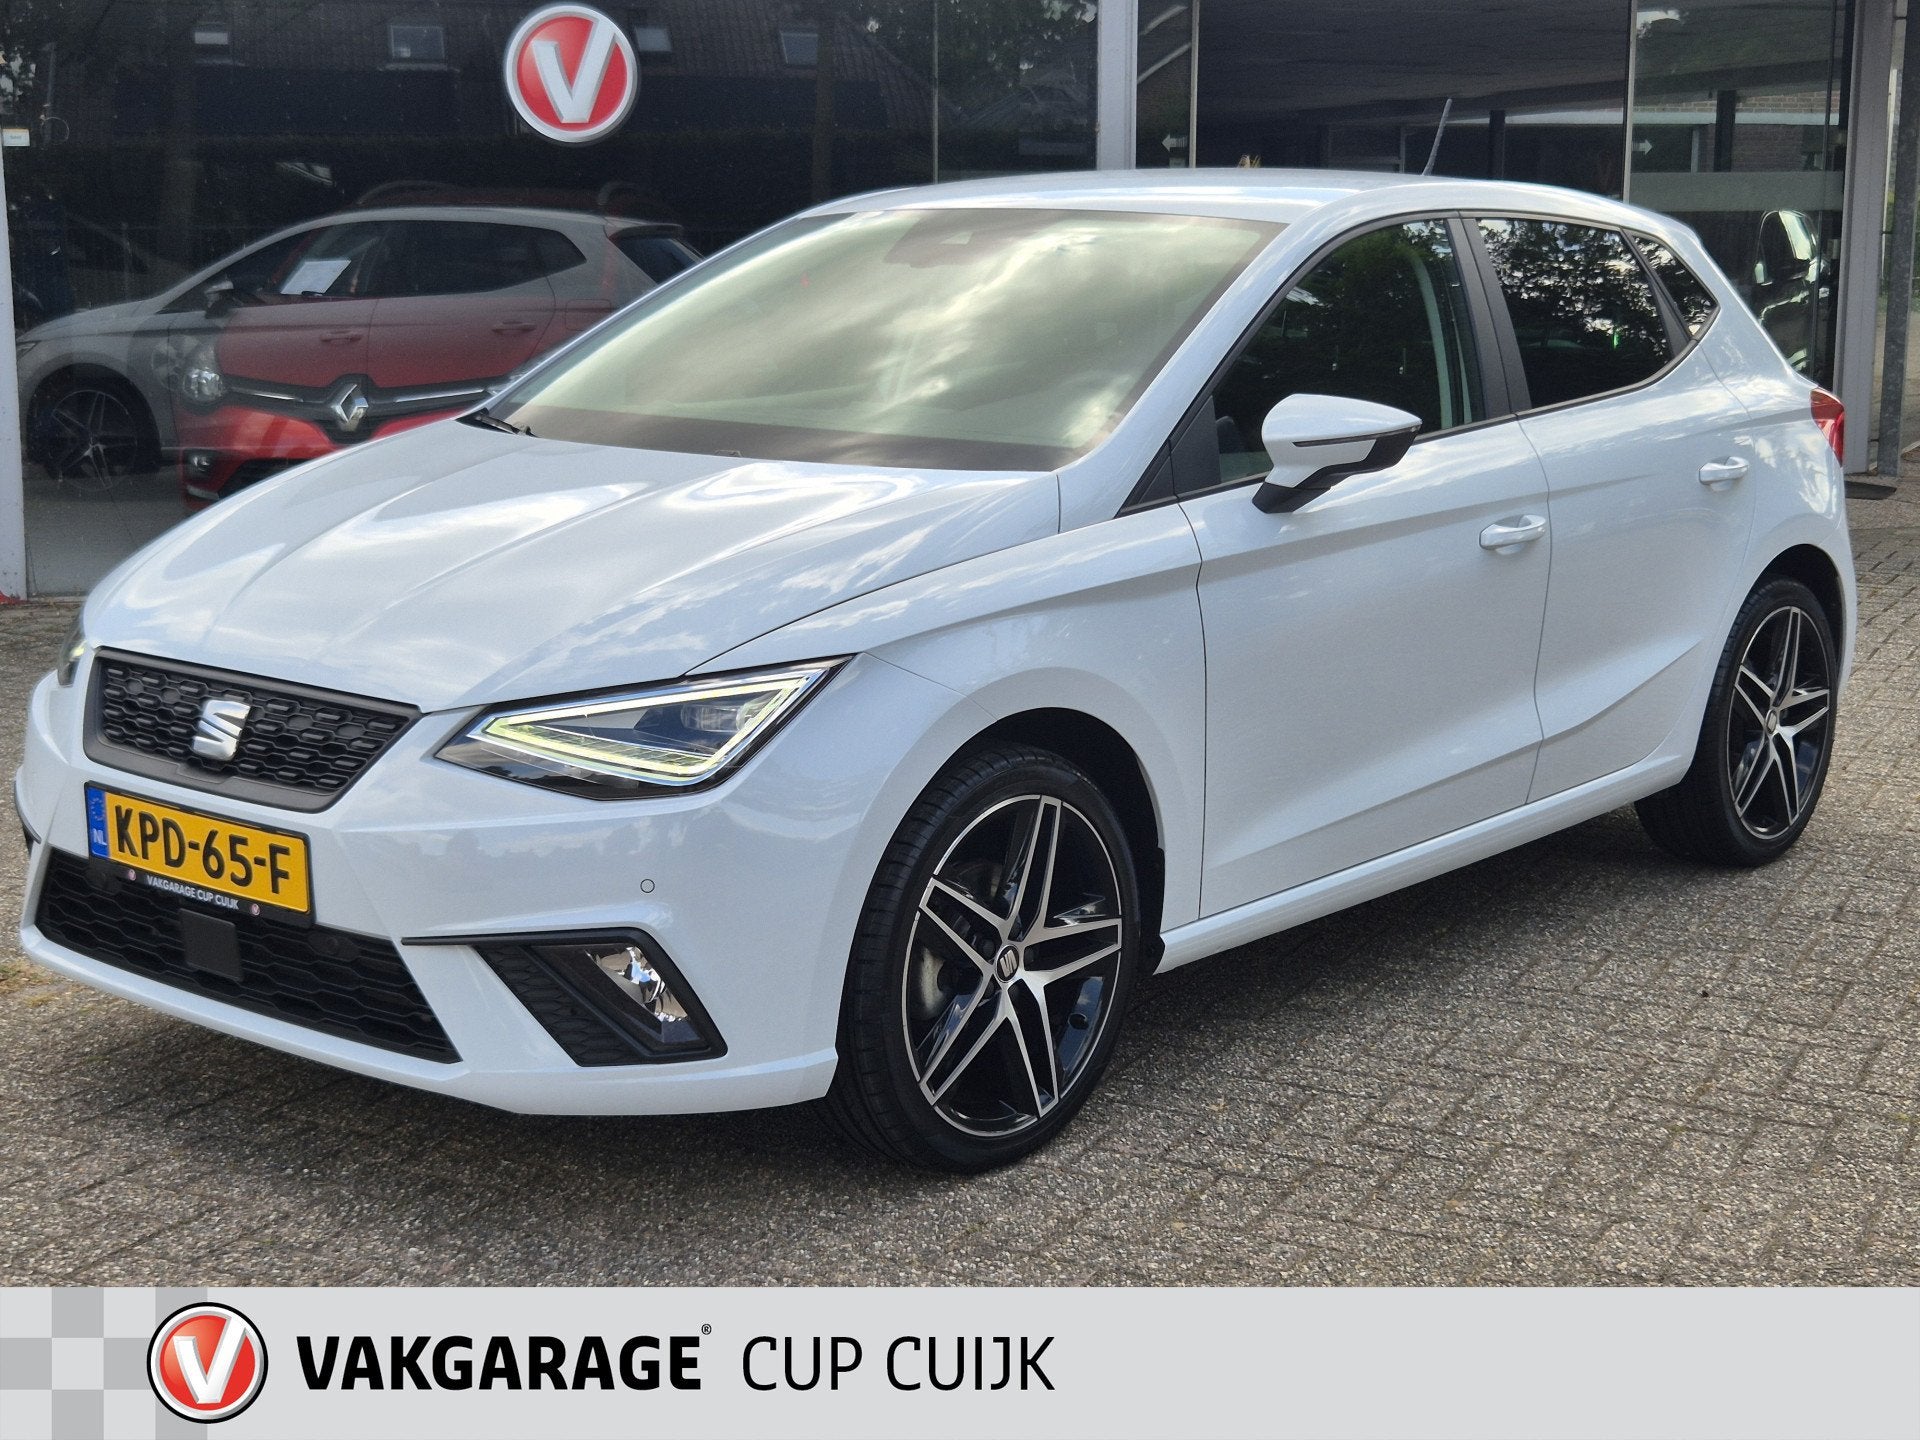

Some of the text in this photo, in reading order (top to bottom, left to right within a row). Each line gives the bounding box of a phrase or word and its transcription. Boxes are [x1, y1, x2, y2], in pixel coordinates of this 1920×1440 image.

[532, 19, 617, 123] V
[93, 829, 107, 846] NL
[115, 805, 290, 894] KPD-65-F
[146, 875, 196, 898] VAKGARAGE
[197, 889, 214, 902] CUP
[215, 894, 239, 910] CUIJK
